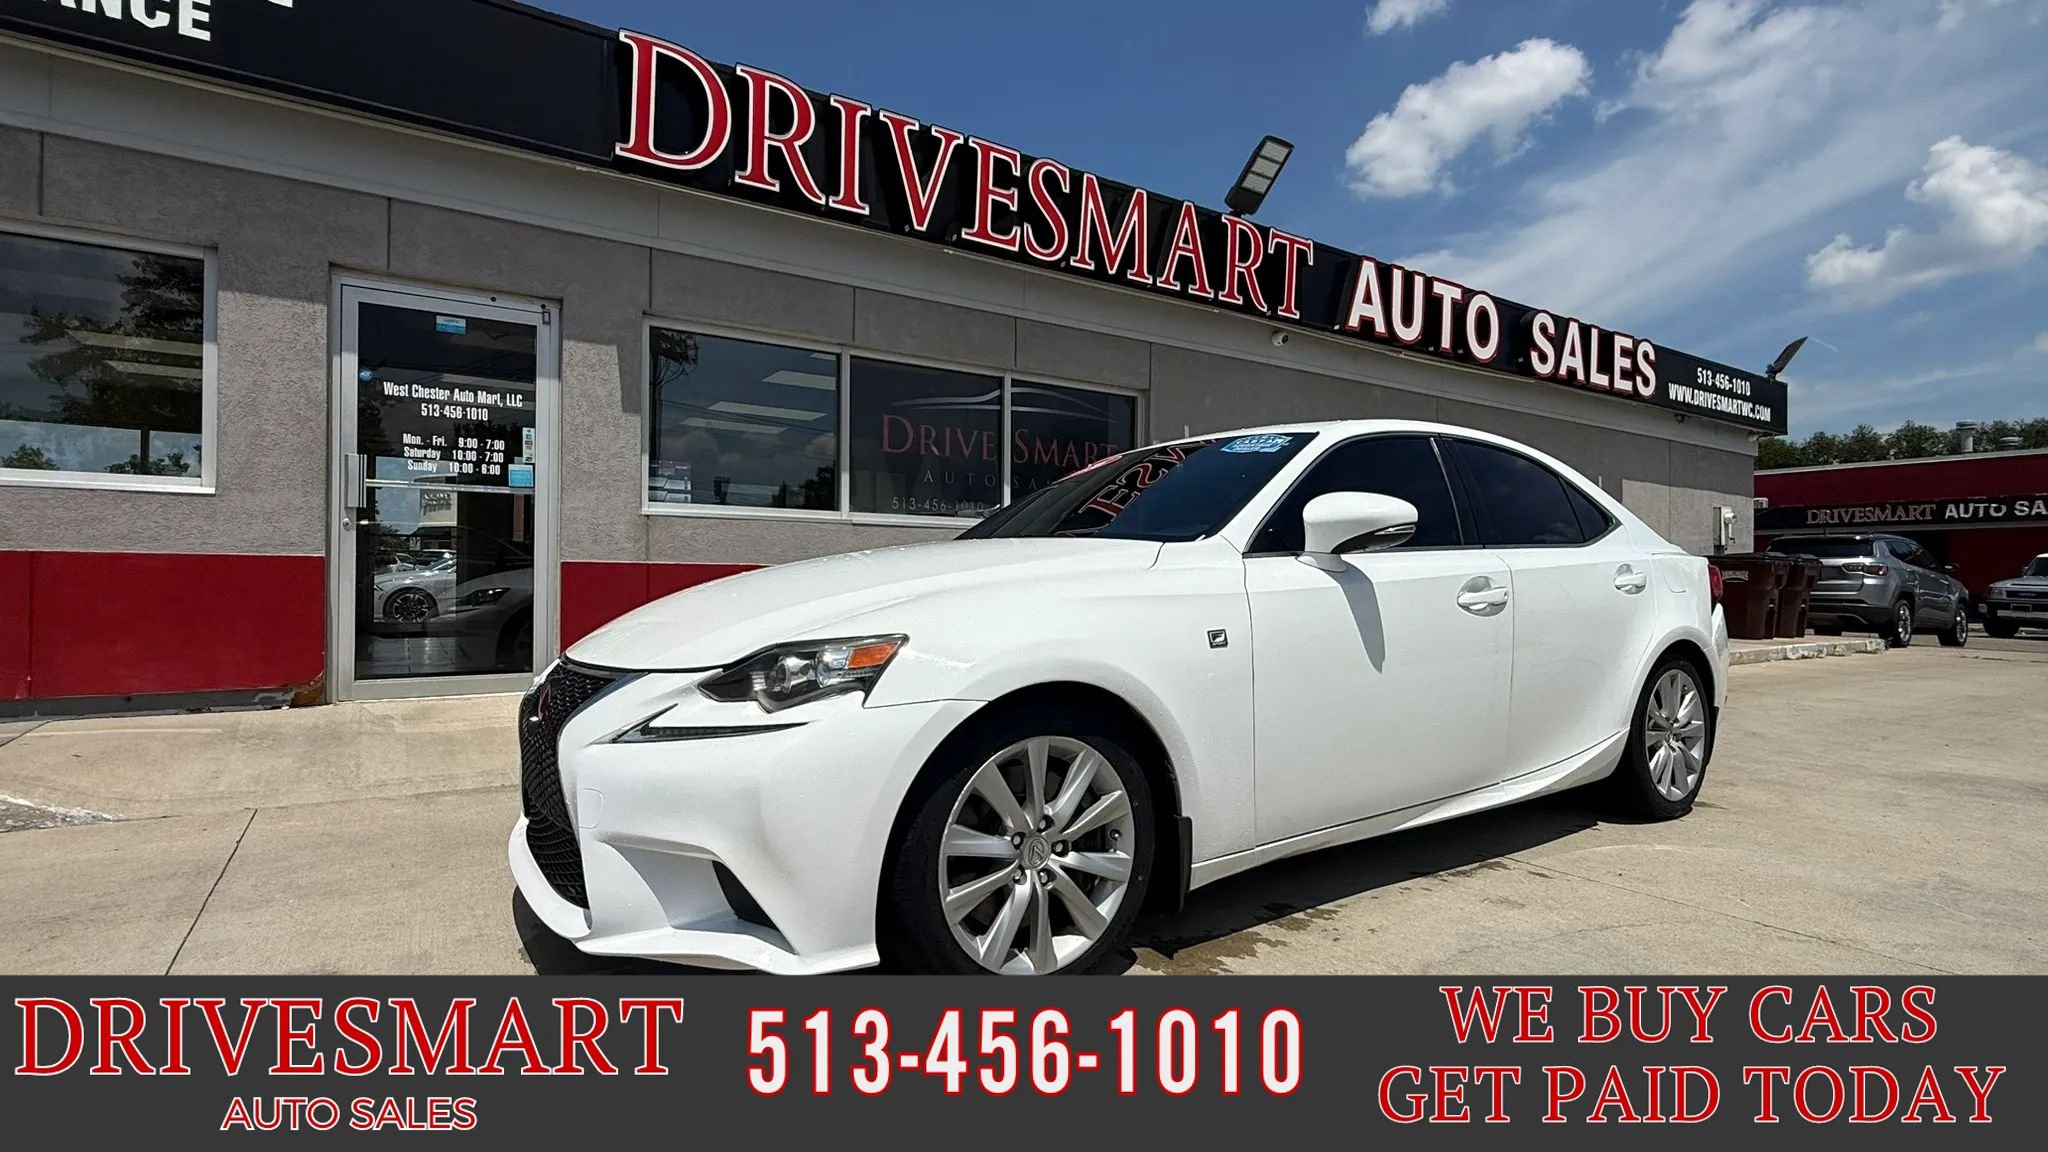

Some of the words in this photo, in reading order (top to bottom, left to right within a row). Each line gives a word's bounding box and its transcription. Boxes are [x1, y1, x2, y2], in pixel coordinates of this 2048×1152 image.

[615, 28, 1314, 319] DRIVESMART
[1345, 258, 1500, 363] AUTO
[1528, 309, 1657, 400] SALES
[1696, 367, 1751, 397] 513-456-1010
[383, 382, 409, 397] West
[412, 384, 451, 400] Chester
[453, 388, 474, 403] Auto
[477, 391, 503, 407] Mart,
[506, 393, 523, 407] LLC
[1668, 381, 1771, 424] WWW.DRIVESMARTWC.COM
[421, 403, 488, 421] 513-456-1010
[403, 434, 424, 446] Mon.
[432, 436, 447, 447] Fri.
[458, 437, 478, 449] 9:00
[485, 439, 505, 451] 7:00
[880, 414, 998, 462] DRIVE
[403, 447, 441, 461] Saturday
[452, 450, 477, 462] 10:00
[485, 452, 504, 463] 7:00
[407, 460, 438, 473] Sunday
[449, 462, 474, 474] 10:00
[481, 464, 501, 475] 6:00
[924, 470, 996, 487] AUTO
[1806, 504, 1937, 525] DRIVESMART
[1945, 502, 2007, 519] AUTO
